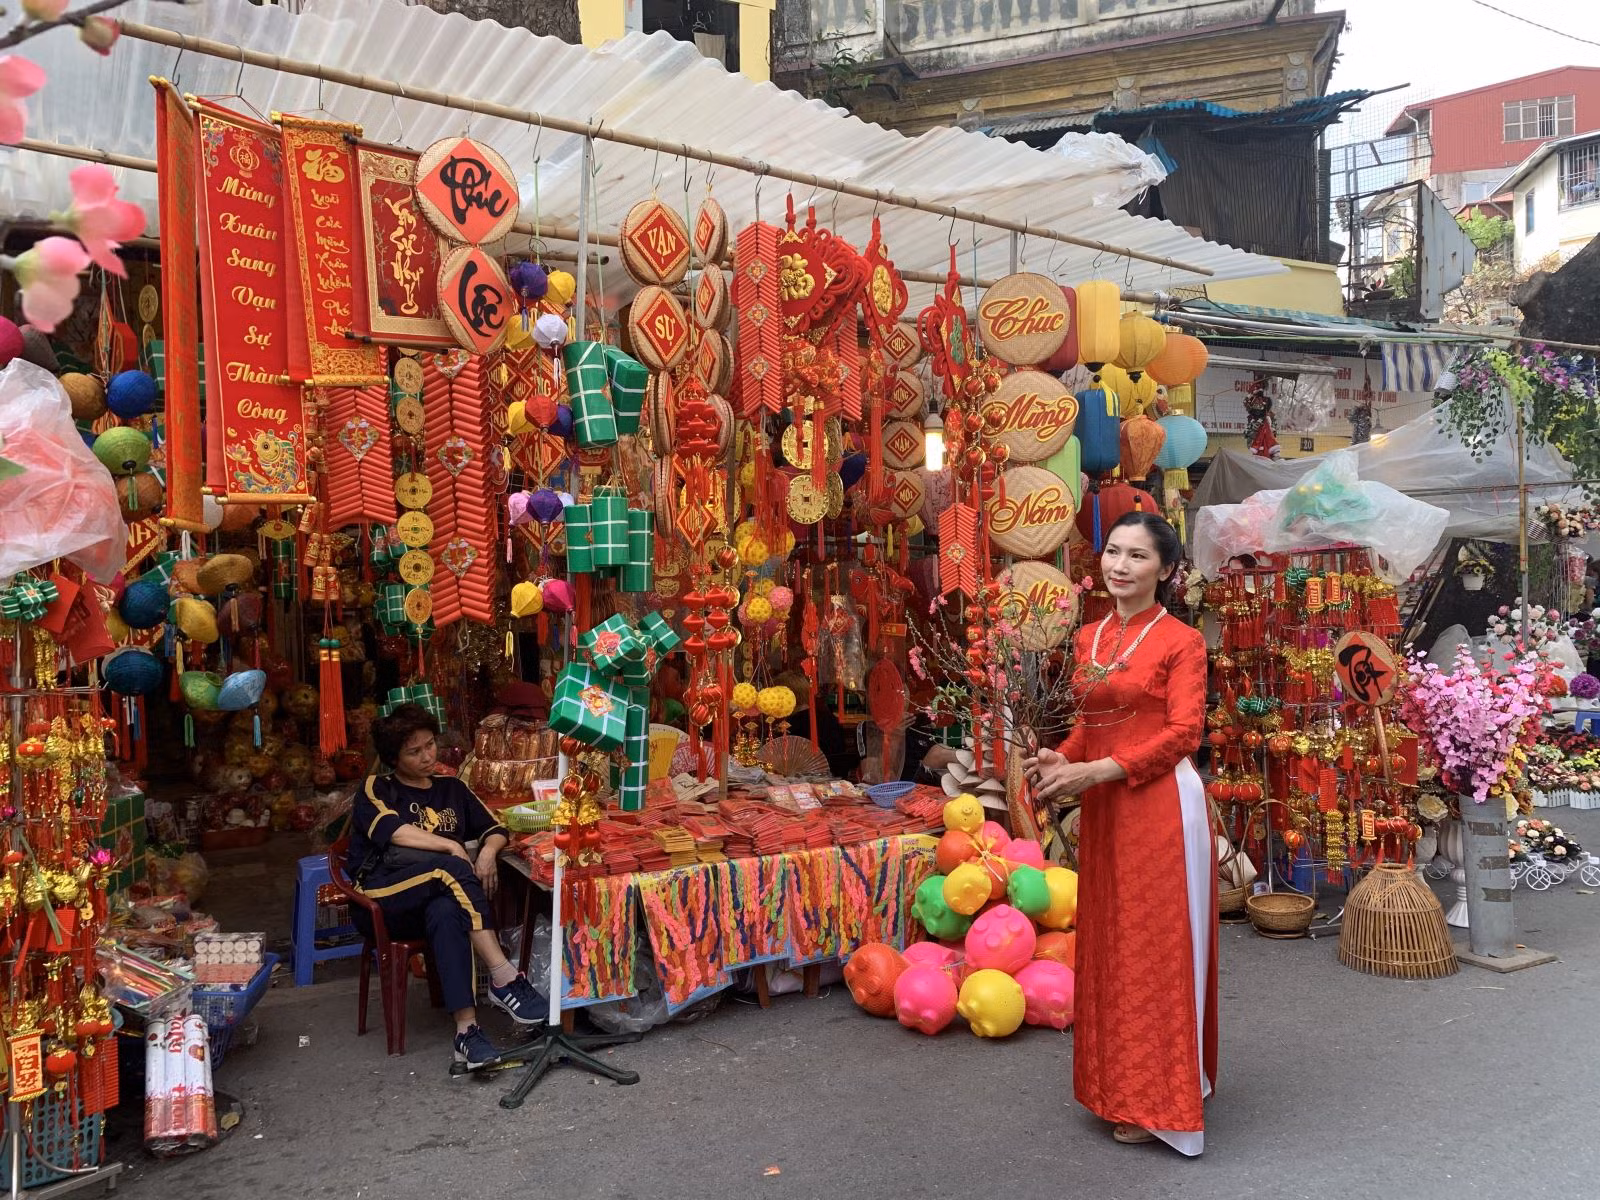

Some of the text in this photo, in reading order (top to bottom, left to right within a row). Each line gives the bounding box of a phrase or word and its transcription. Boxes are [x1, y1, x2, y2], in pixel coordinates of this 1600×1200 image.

[216, 176, 276, 208] Mừng
[439, 155, 510, 225] Phúc
[219, 213, 277, 241] Xuân
[647, 227, 677, 265] VẠN
[226, 248, 277, 277] Sang
[231, 285, 277, 312] Vạn
[654, 313, 676, 347] SỰ
[980, 296, 1066, 341] Chúc
[243, 325, 272, 350] Sự
[237, 398, 289, 425] Công
[988, 484, 1073, 534] Năm
